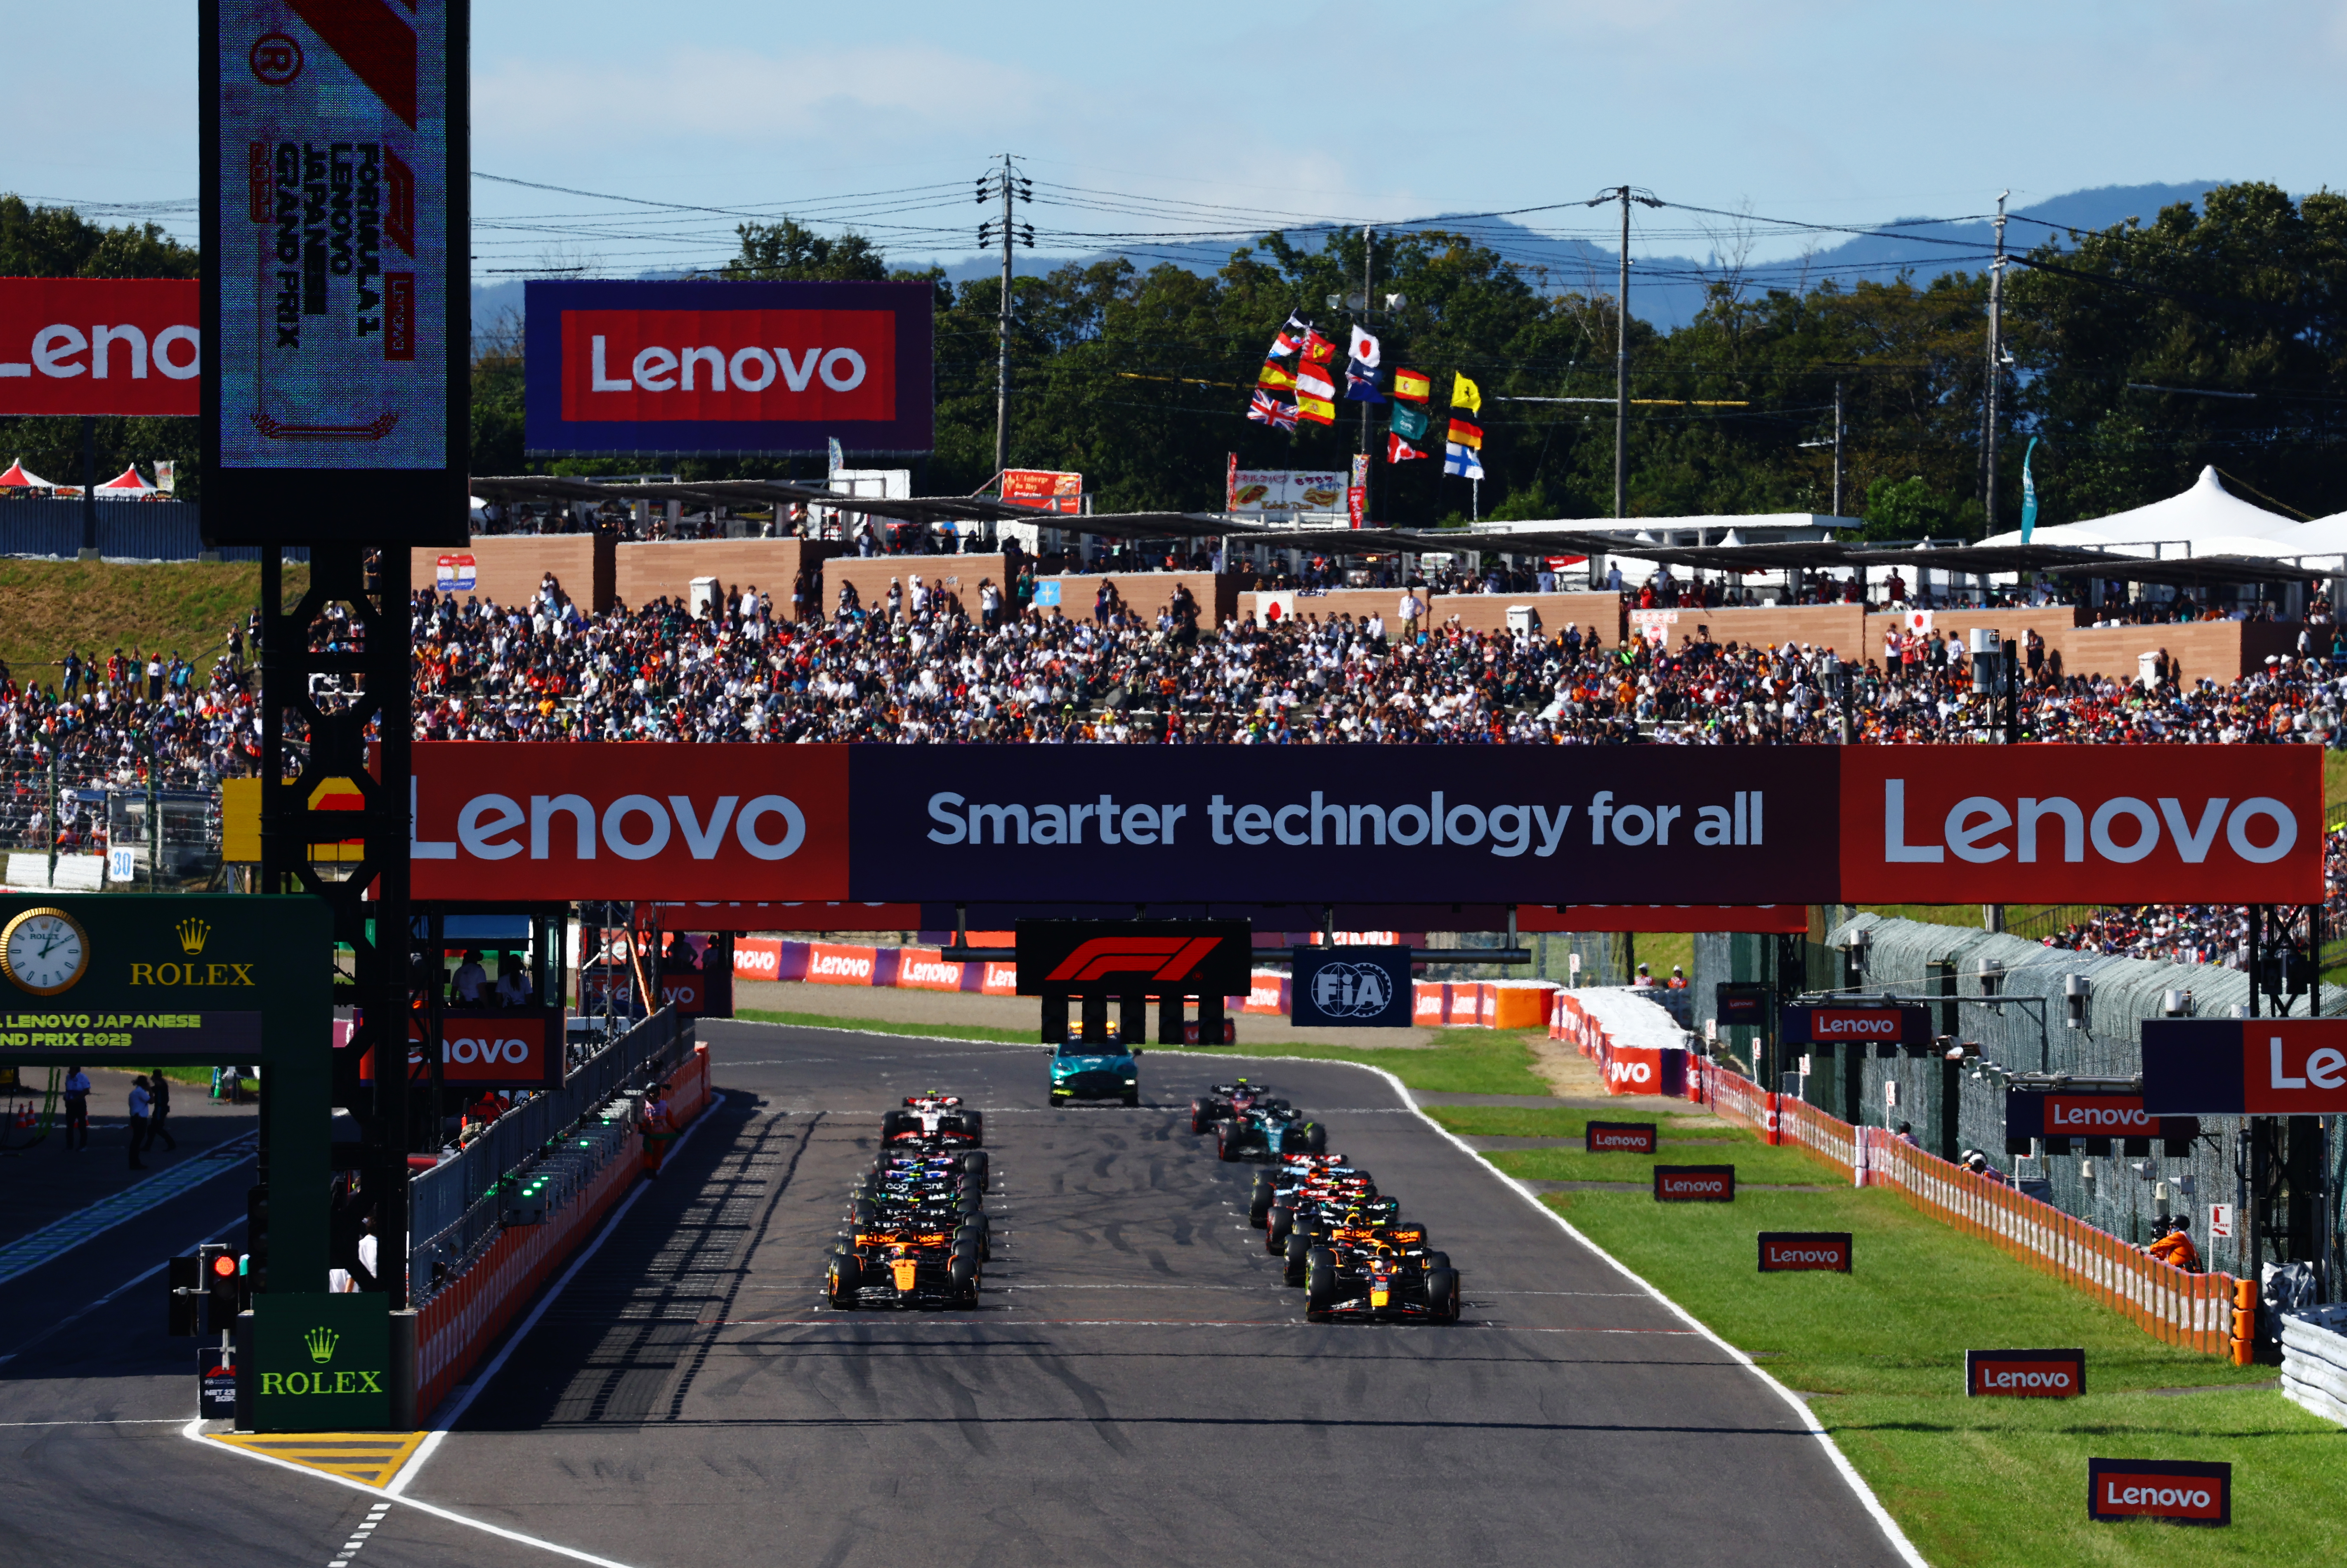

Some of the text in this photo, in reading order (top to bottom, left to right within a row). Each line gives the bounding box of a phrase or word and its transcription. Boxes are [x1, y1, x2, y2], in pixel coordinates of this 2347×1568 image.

[331, 144, 353, 276] LENOVO
[303, 143, 326, 315] JAPANESE
[357, 144, 380, 337] FORMULA 1
[276, 143, 299, 349] GRAND PRIX
[391, 279, 411, 351] Lenovo
[593, 335, 866, 392] Lenovo
[411, 776, 805, 861] Lenovo
[927, 790, 1763, 857] Smarter technology for all
[1885, 779, 2297, 863] Lenovo
[114, 852, 131, 875] 30
[130, 963, 255, 986] ROLEX
[812, 952, 870, 977] Lenovo
[902, 957, 957, 984] Lenovo
[6, 1014, 201, 1028] LENOVO JAPANESE
[1819, 1016, 1894, 1033] Lenovo
[31, 1033, 79, 1046] PRIX
[83, 1033, 132, 1046] 2023
[2054, 1104, 2149, 1125] Lenovo
[1596, 1134, 1647, 1146] Lenovo
[1665, 1179, 1722, 1192] Lenovo
[1771, 1247, 1838, 1263] Lenovo
[260, 1371, 383, 1395] ROLEX
[1985, 1369, 2070, 1387] Lenovo
[2108, 1482, 2210, 1508] Lenovo
